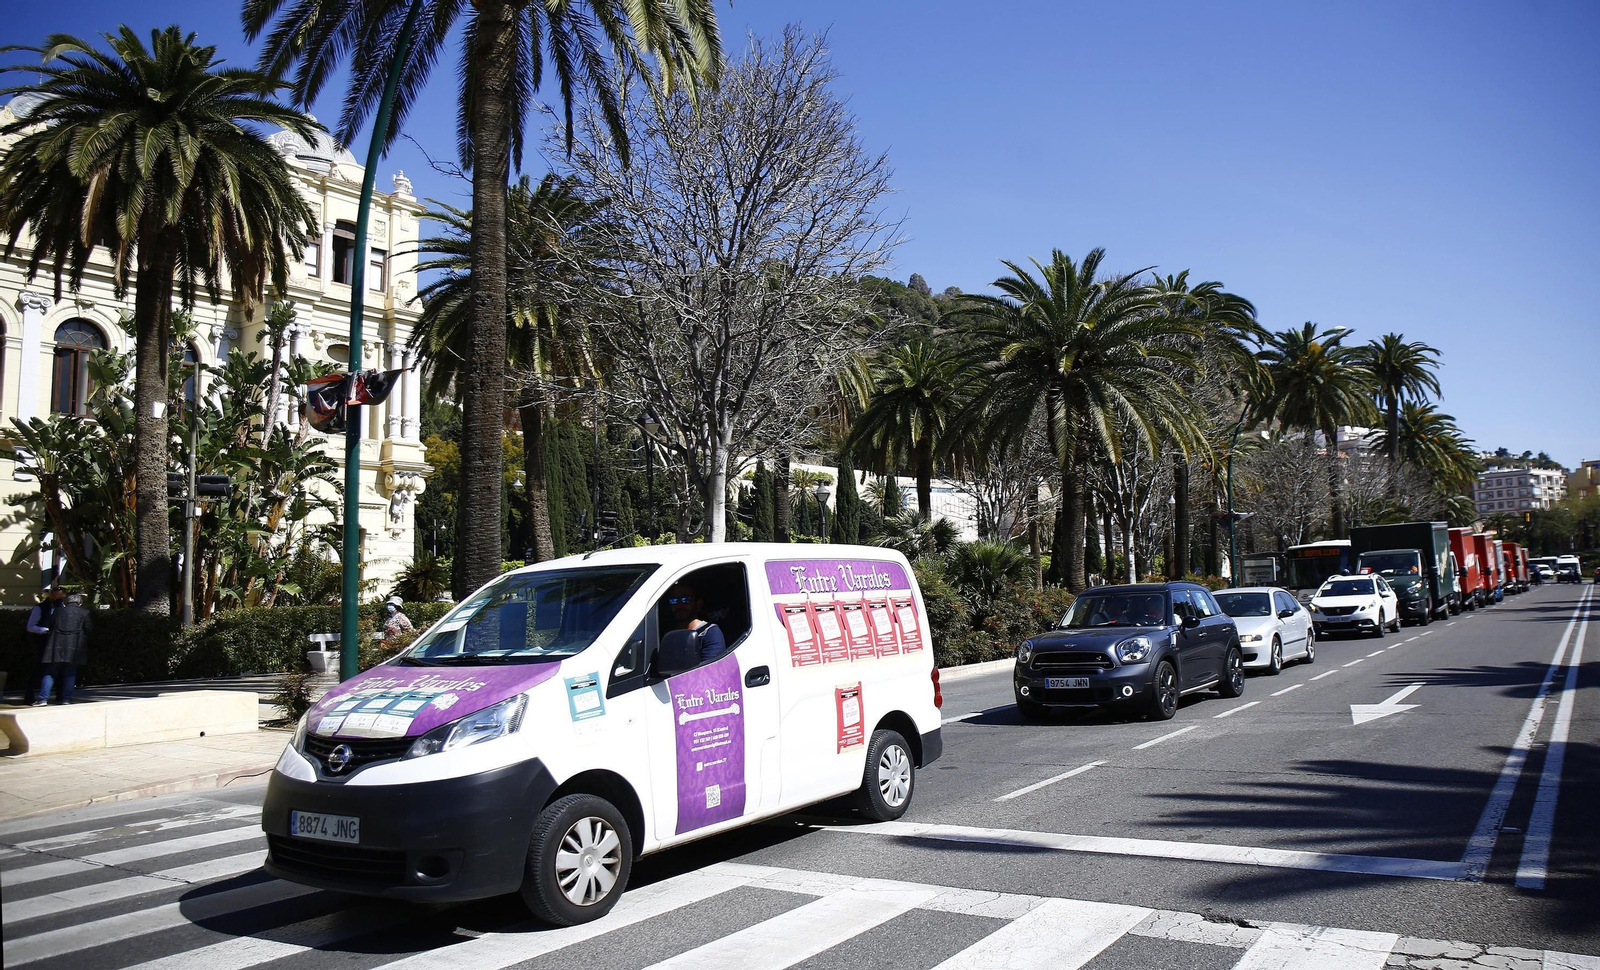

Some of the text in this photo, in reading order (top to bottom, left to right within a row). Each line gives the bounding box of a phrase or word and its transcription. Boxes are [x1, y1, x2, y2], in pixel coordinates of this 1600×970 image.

[790, 563, 892, 594] Entre Varales
[408, 674, 486, 692] Varales
[1050, 679, 1070, 688] 9754
[675, 686, 740, 710] Entre Varales
[299, 815, 357, 839] 8874 JNG
